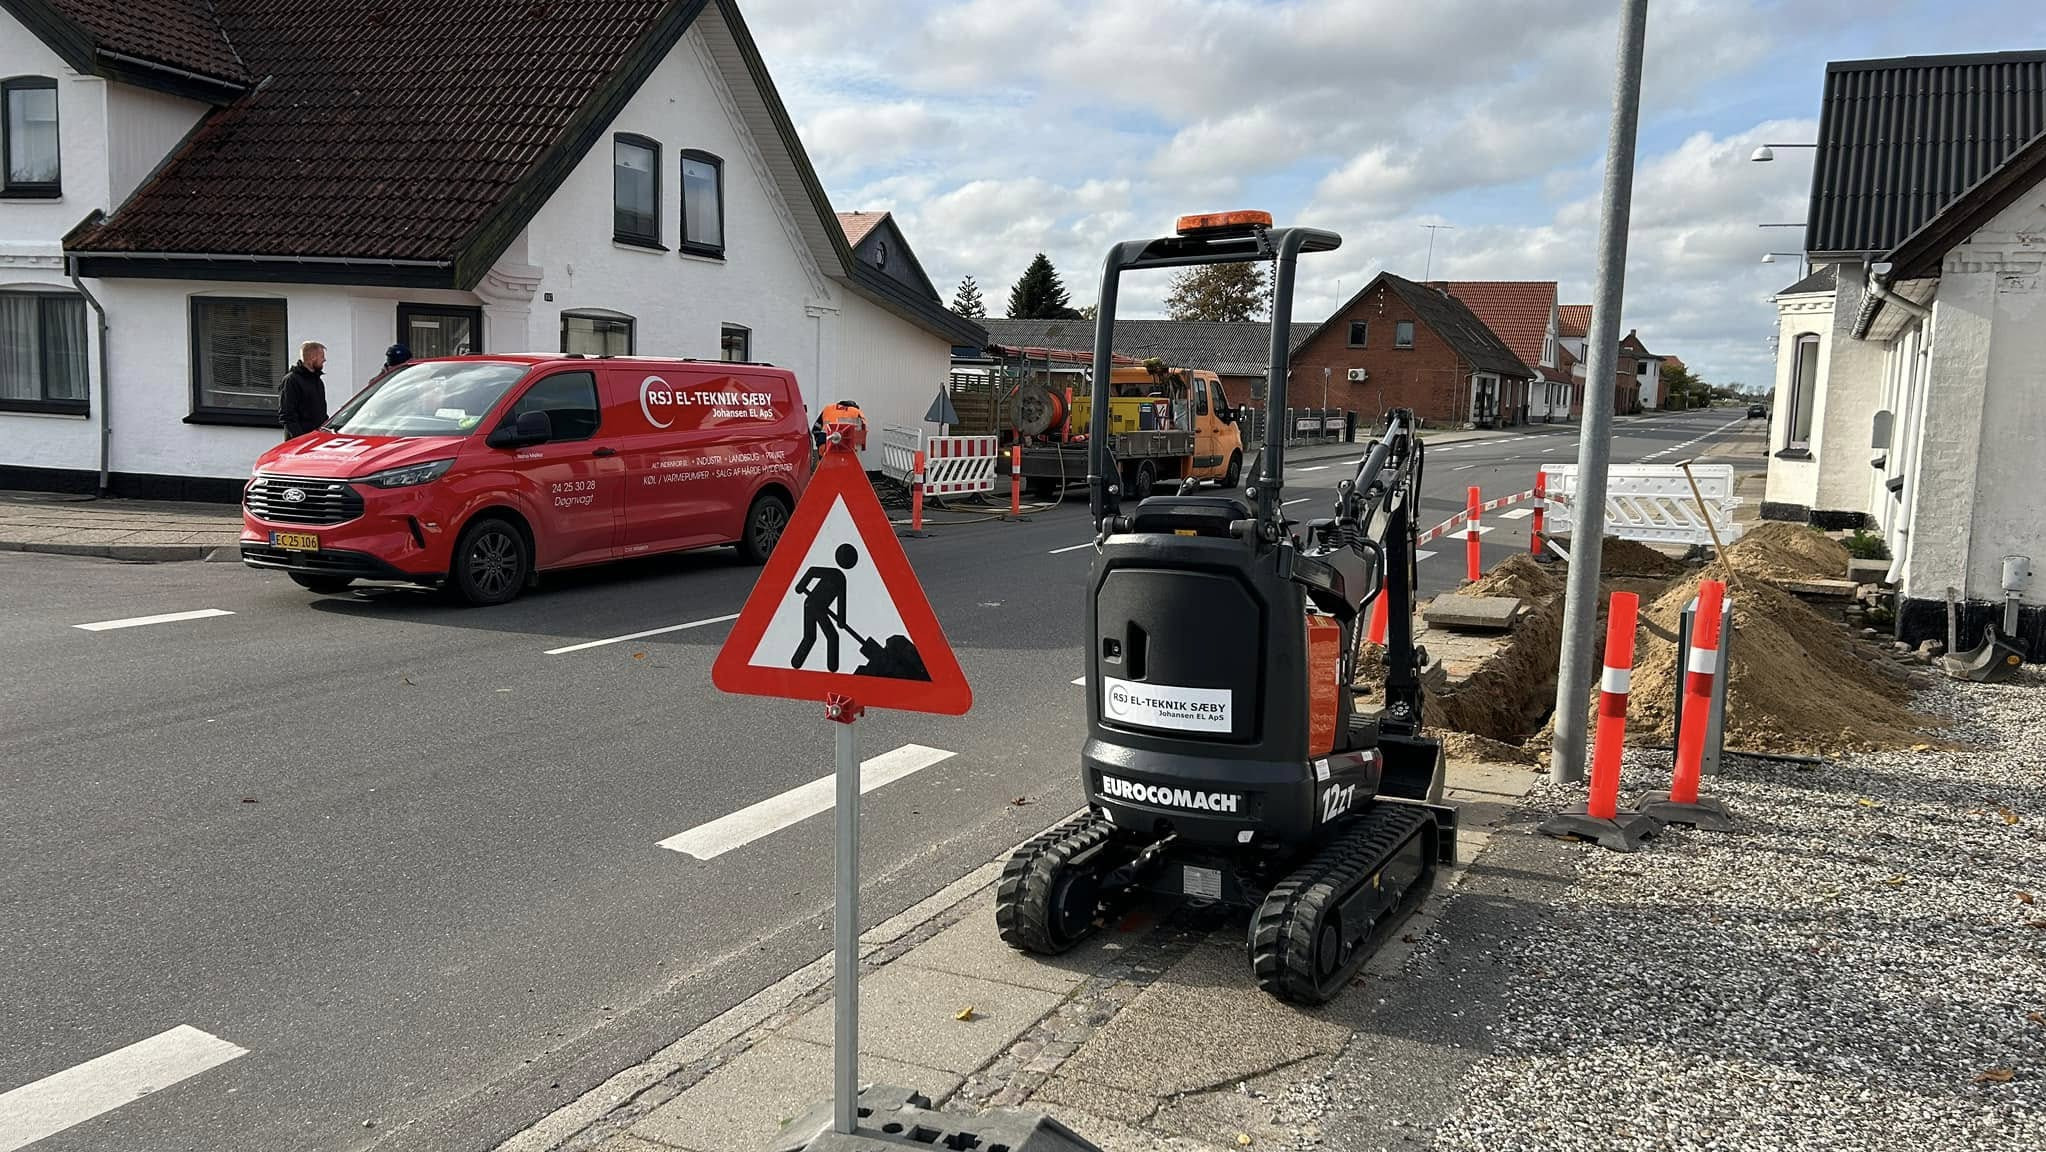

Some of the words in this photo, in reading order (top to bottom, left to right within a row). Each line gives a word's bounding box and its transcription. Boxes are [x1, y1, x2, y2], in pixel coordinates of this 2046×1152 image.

[648, 391, 673, 405] RSJ
[676, 391, 740, 406] EL-TEKNIK
[741, 393, 772, 406] SÆBY
[712, 408, 747, 418] Johansen
[749, 409, 758, 418] EL
[759, 409, 773, 419] ApS
[715, 468, 732, 478] SALG
[552, 483, 562, 493] 24
[564, 482, 573, 492] 25
[575, 481, 585, 490] 30
[586, 480, 596, 490] 28
[276, 534, 287, 546] EC
[289, 535, 299, 547] 25
[301, 536, 317, 549] 106
[1113, 692, 1128, 703] RSJ
[1130, 695, 1187, 711] EL-TEKNIK
[1190, 702, 1226, 713] SÆBY
[1159, 710, 1194, 719] Johansen
[1208, 714, 1224, 722] ApS
[1102, 775, 1237, 813] EUROCOMACH
